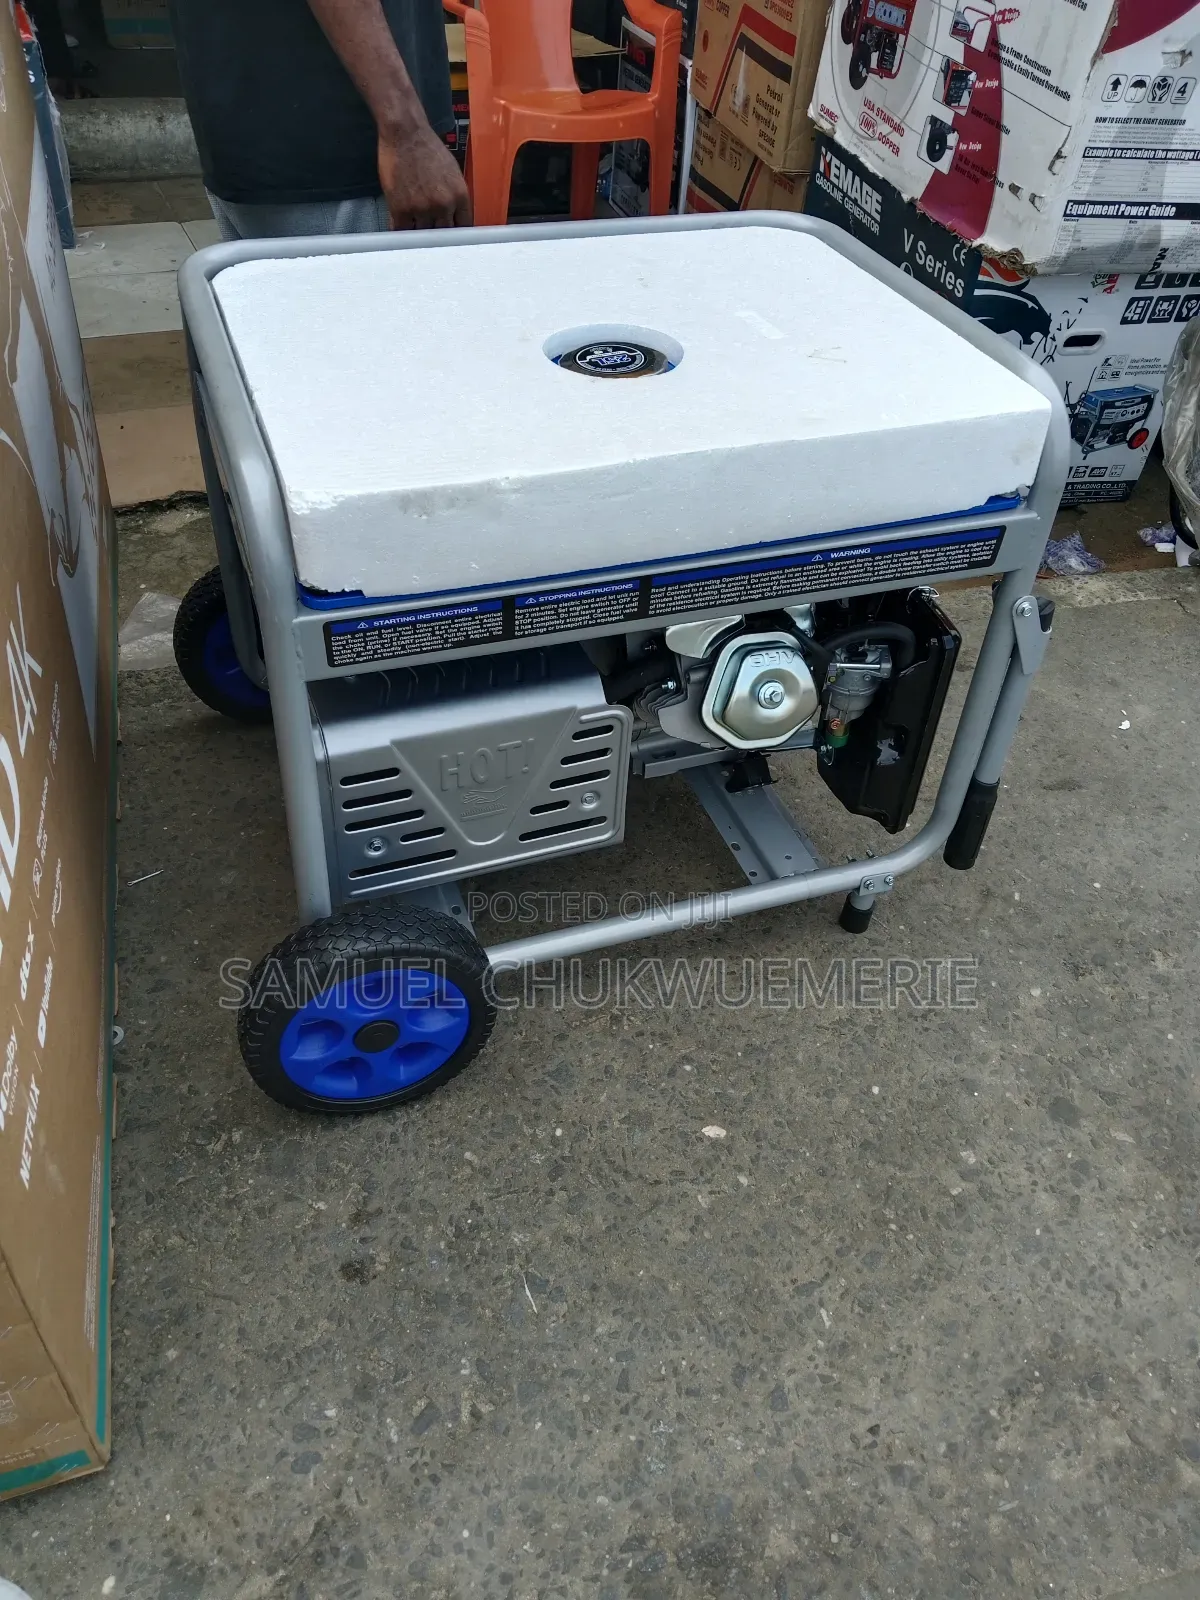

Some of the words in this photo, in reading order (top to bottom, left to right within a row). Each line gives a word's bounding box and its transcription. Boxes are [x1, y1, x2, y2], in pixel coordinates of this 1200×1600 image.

[1004, 9, 1019, 21] Design
[1010, 46, 1024, 61] Frame
[1023, 54, 1052, 77] Construction
[975, 80, 984, 89] New
[985, 78, 999, 89] Design
[1017, 63, 1030, 79] Easily
[1030, 70, 1045, 87] Turned
[1045, 78, 1056, 93] Over
[1055, 86, 1071, 102] Handle
[1176, 82, 1189, 96] 4
[766, 85, 783, 103] Petrol
[1106, 91, 1119, 100] UP
[752, 107, 772, 130] Powered
[771, 123, 778, 135] by
[819, 103, 839, 123] SUMEC
[863, 97, 875, 113] USA
[875, 106, 905, 138] STANDARD
[1094, 116, 1108, 124] HOW
[1108, 116, 1115, 124] TO
[1114, 117, 1133, 125] SELECT
[1133, 117, 1142, 125] THE
[1141, 117, 1157, 125] RIGHT
[1157, 118, 1187, 126] GENERATOR
[860, 114, 876, 136] 100%
[877, 131, 900, 158] COPPER
[958, 142, 968, 150] New
[968, 141, 982, 152] Design
[1084, 148, 1114, 158] Example
[1113, 148, 1121, 157] to
[1121, 148, 1154, 158] calculate
[1154, 149, 1166, 158] the
[1166, 150, 1193, 160] wattage
[819, 146, 883, 222] YEMAGE
[815, 172, 843, 204] GASOLINE
[843, 198, 880, 236] GENERATOR
[1066, 202, 1119, 216] Equipment
[1118, 204, 1149, 216] Power
[1148, 205, 1176, 217] Guide
[903, 227, 915, 254] V
[915, 240, 965, 298] Series
[830, 548, 871, 558] WARNING
[538, 592, 577, 602] STOPPING
[578, 583, 633, 596] INSTRUCTIONS
[373, 616, 416, 626] STARTING
[417, 606, 478, 620] INSTRUCTIONS
[474, 612, 503, 620] electrical
[515, 606, 540, 614] Remove
[558, 601, 580, 613] electric
[530, 609, 557, 617] minutes.
[569, 605, 589, 619] engine
[533, 614, 559, 624] position.
[596, 604, 625, 613] generator
[382, 632, 400, 640] Open
[483, 617, 503, 625] Adjust
[524, 627, 547, 636] storage
[555, 620, 582, 630] transport
[532, 619, 565, 629] completely
[565, 613, 591, 623] stopped.
[6, 580, 43, 759] 4K
[439, 737, 536, 792] HOT!
[41, 955, 54, 1015] YouTube
[2, 1025, 18, 1097] Dolby
[9, 1064, 19, 1116] VISION
[19, 1073, 40, 1191] NETFLIX
